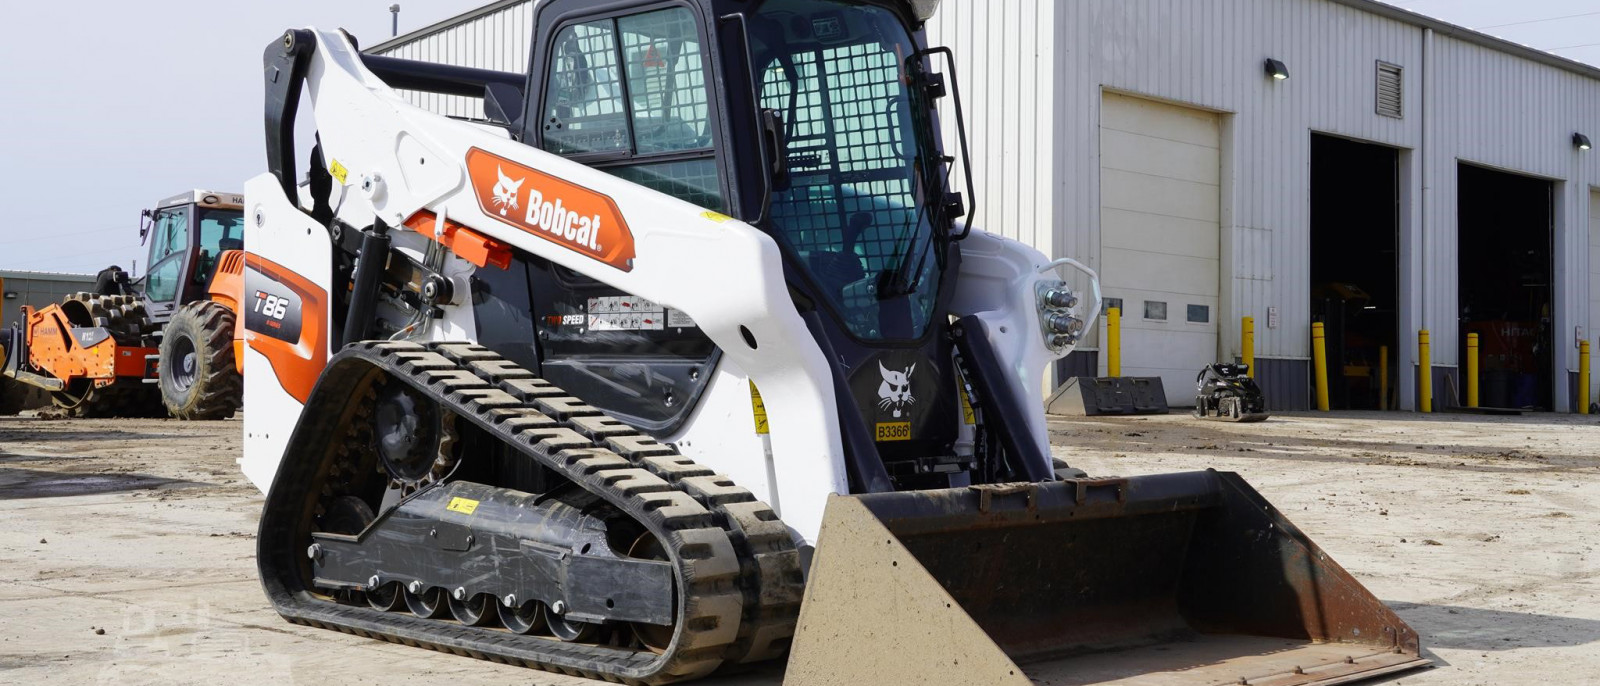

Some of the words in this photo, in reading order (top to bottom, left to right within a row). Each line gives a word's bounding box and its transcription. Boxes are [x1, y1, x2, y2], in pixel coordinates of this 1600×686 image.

[525, 189, 600, 250] Bobcat
[254, 290, 289, 320] T86
[562, 315, 584, 325] SPEED
[879, 425, 908, 438] B3366
